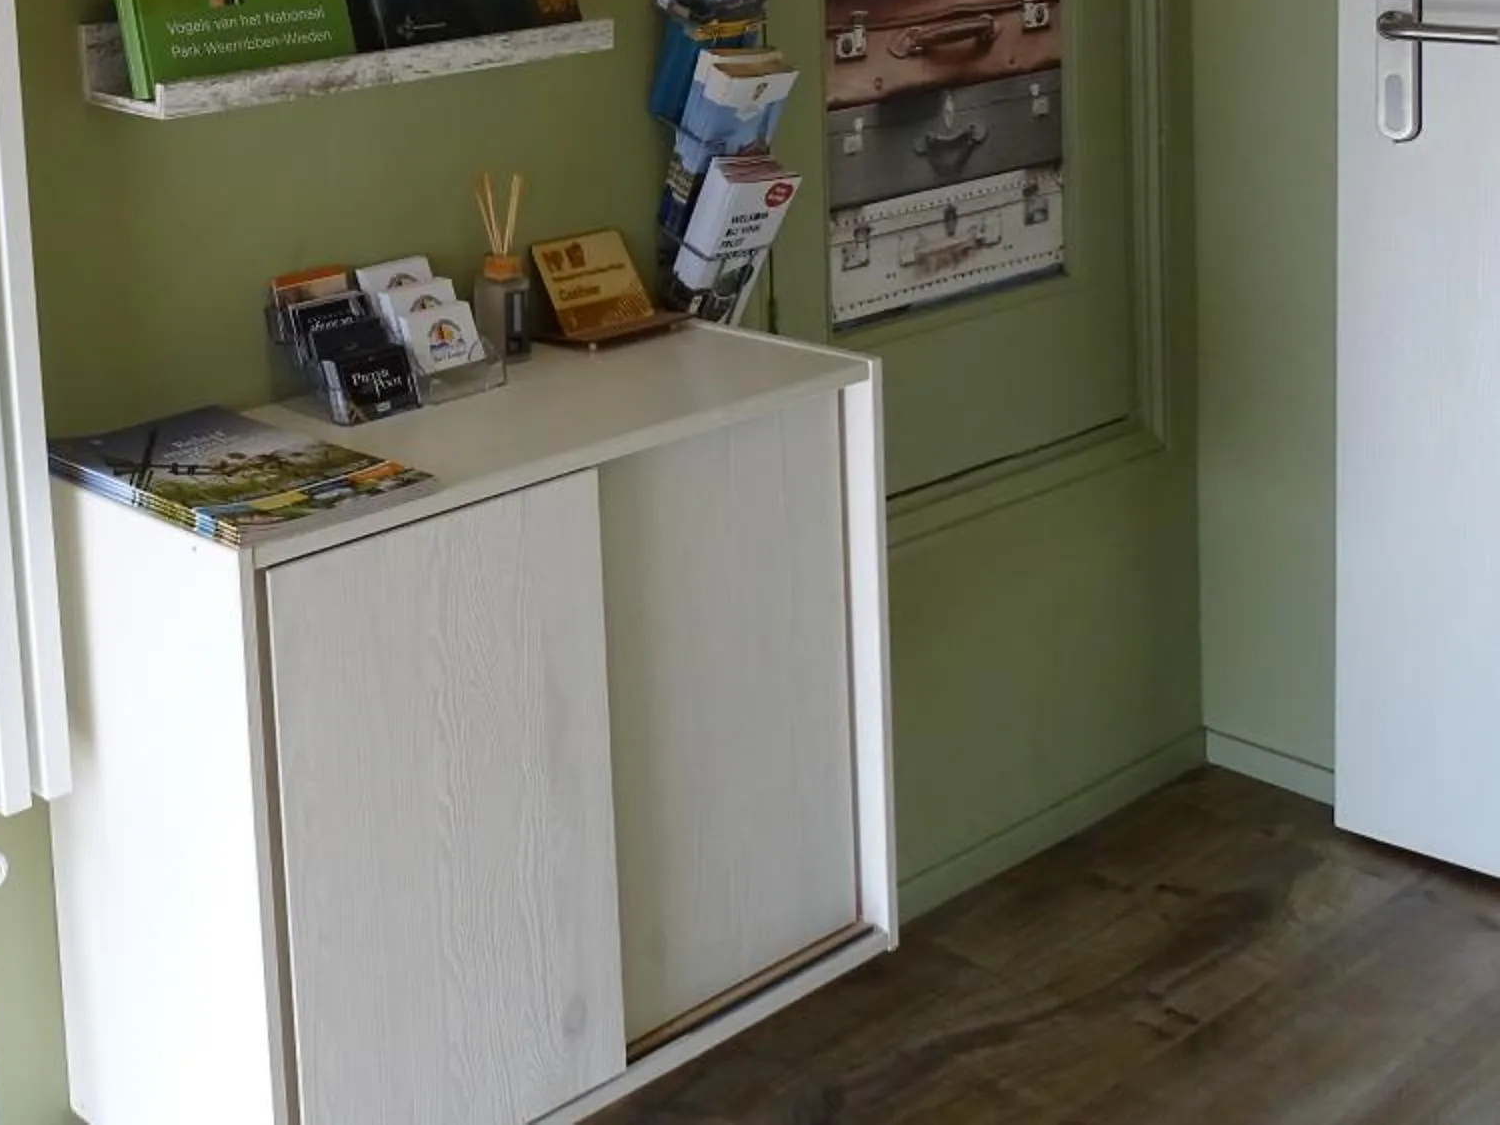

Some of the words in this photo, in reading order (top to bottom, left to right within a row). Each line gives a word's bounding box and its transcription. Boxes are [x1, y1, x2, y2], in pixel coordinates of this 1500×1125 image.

[165, 15, 212, 36] Vogels
[215, 15, 238, 30] van
[239, 11, 261, 27] het
[264, 5, 325, 24] Nationaal
[171, 41, 201, 58] Park
